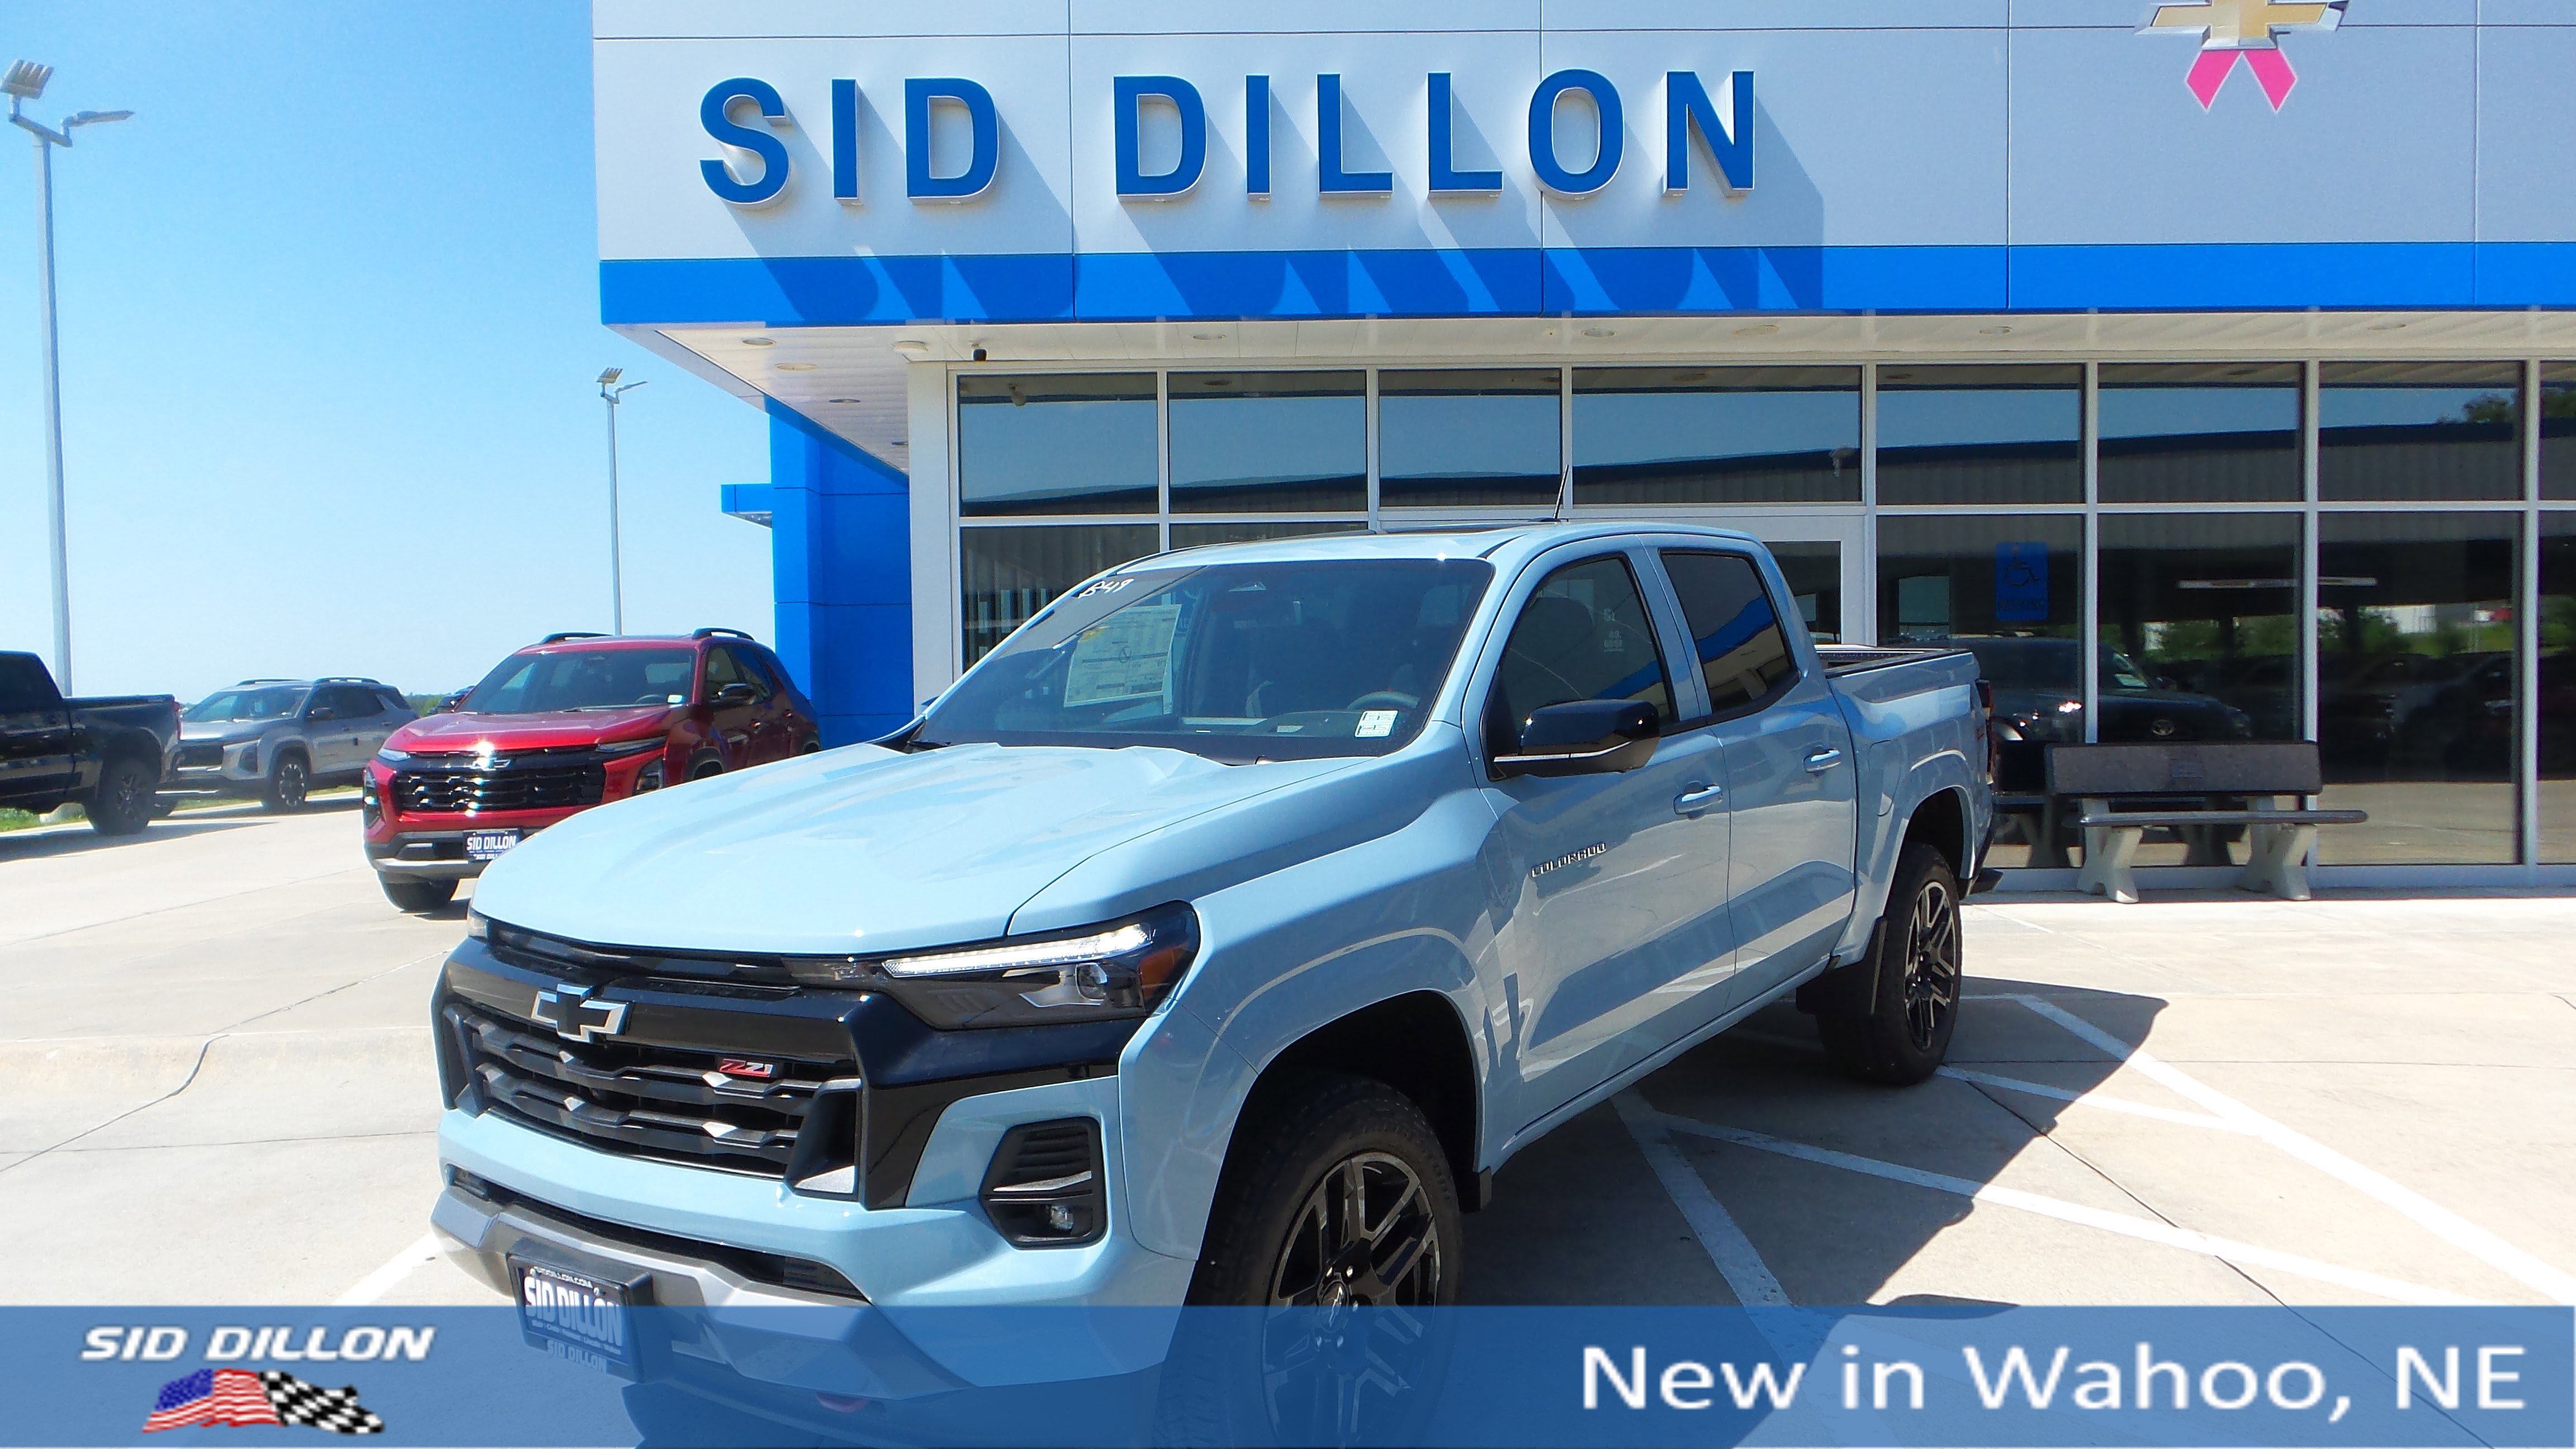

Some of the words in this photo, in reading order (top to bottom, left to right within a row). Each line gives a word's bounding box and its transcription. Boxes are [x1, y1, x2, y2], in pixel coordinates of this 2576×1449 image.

[699, 76, 1001, 206] SID
[1112, 68, 1755, 200] DILLON
[466, 836, 482, 850] SID
[484, 835, 517, 850] DILLON
[1531, 842, 1607, 878] COLORADO
[719, 1058, 774, 1078] Z71
[524, 1276, 556, 1323] SID
[556, 1286, 623, 1347] DILLON
[547, 1339, 566, 1358] SID
[568, 1346, 607, 1374] DILLON
